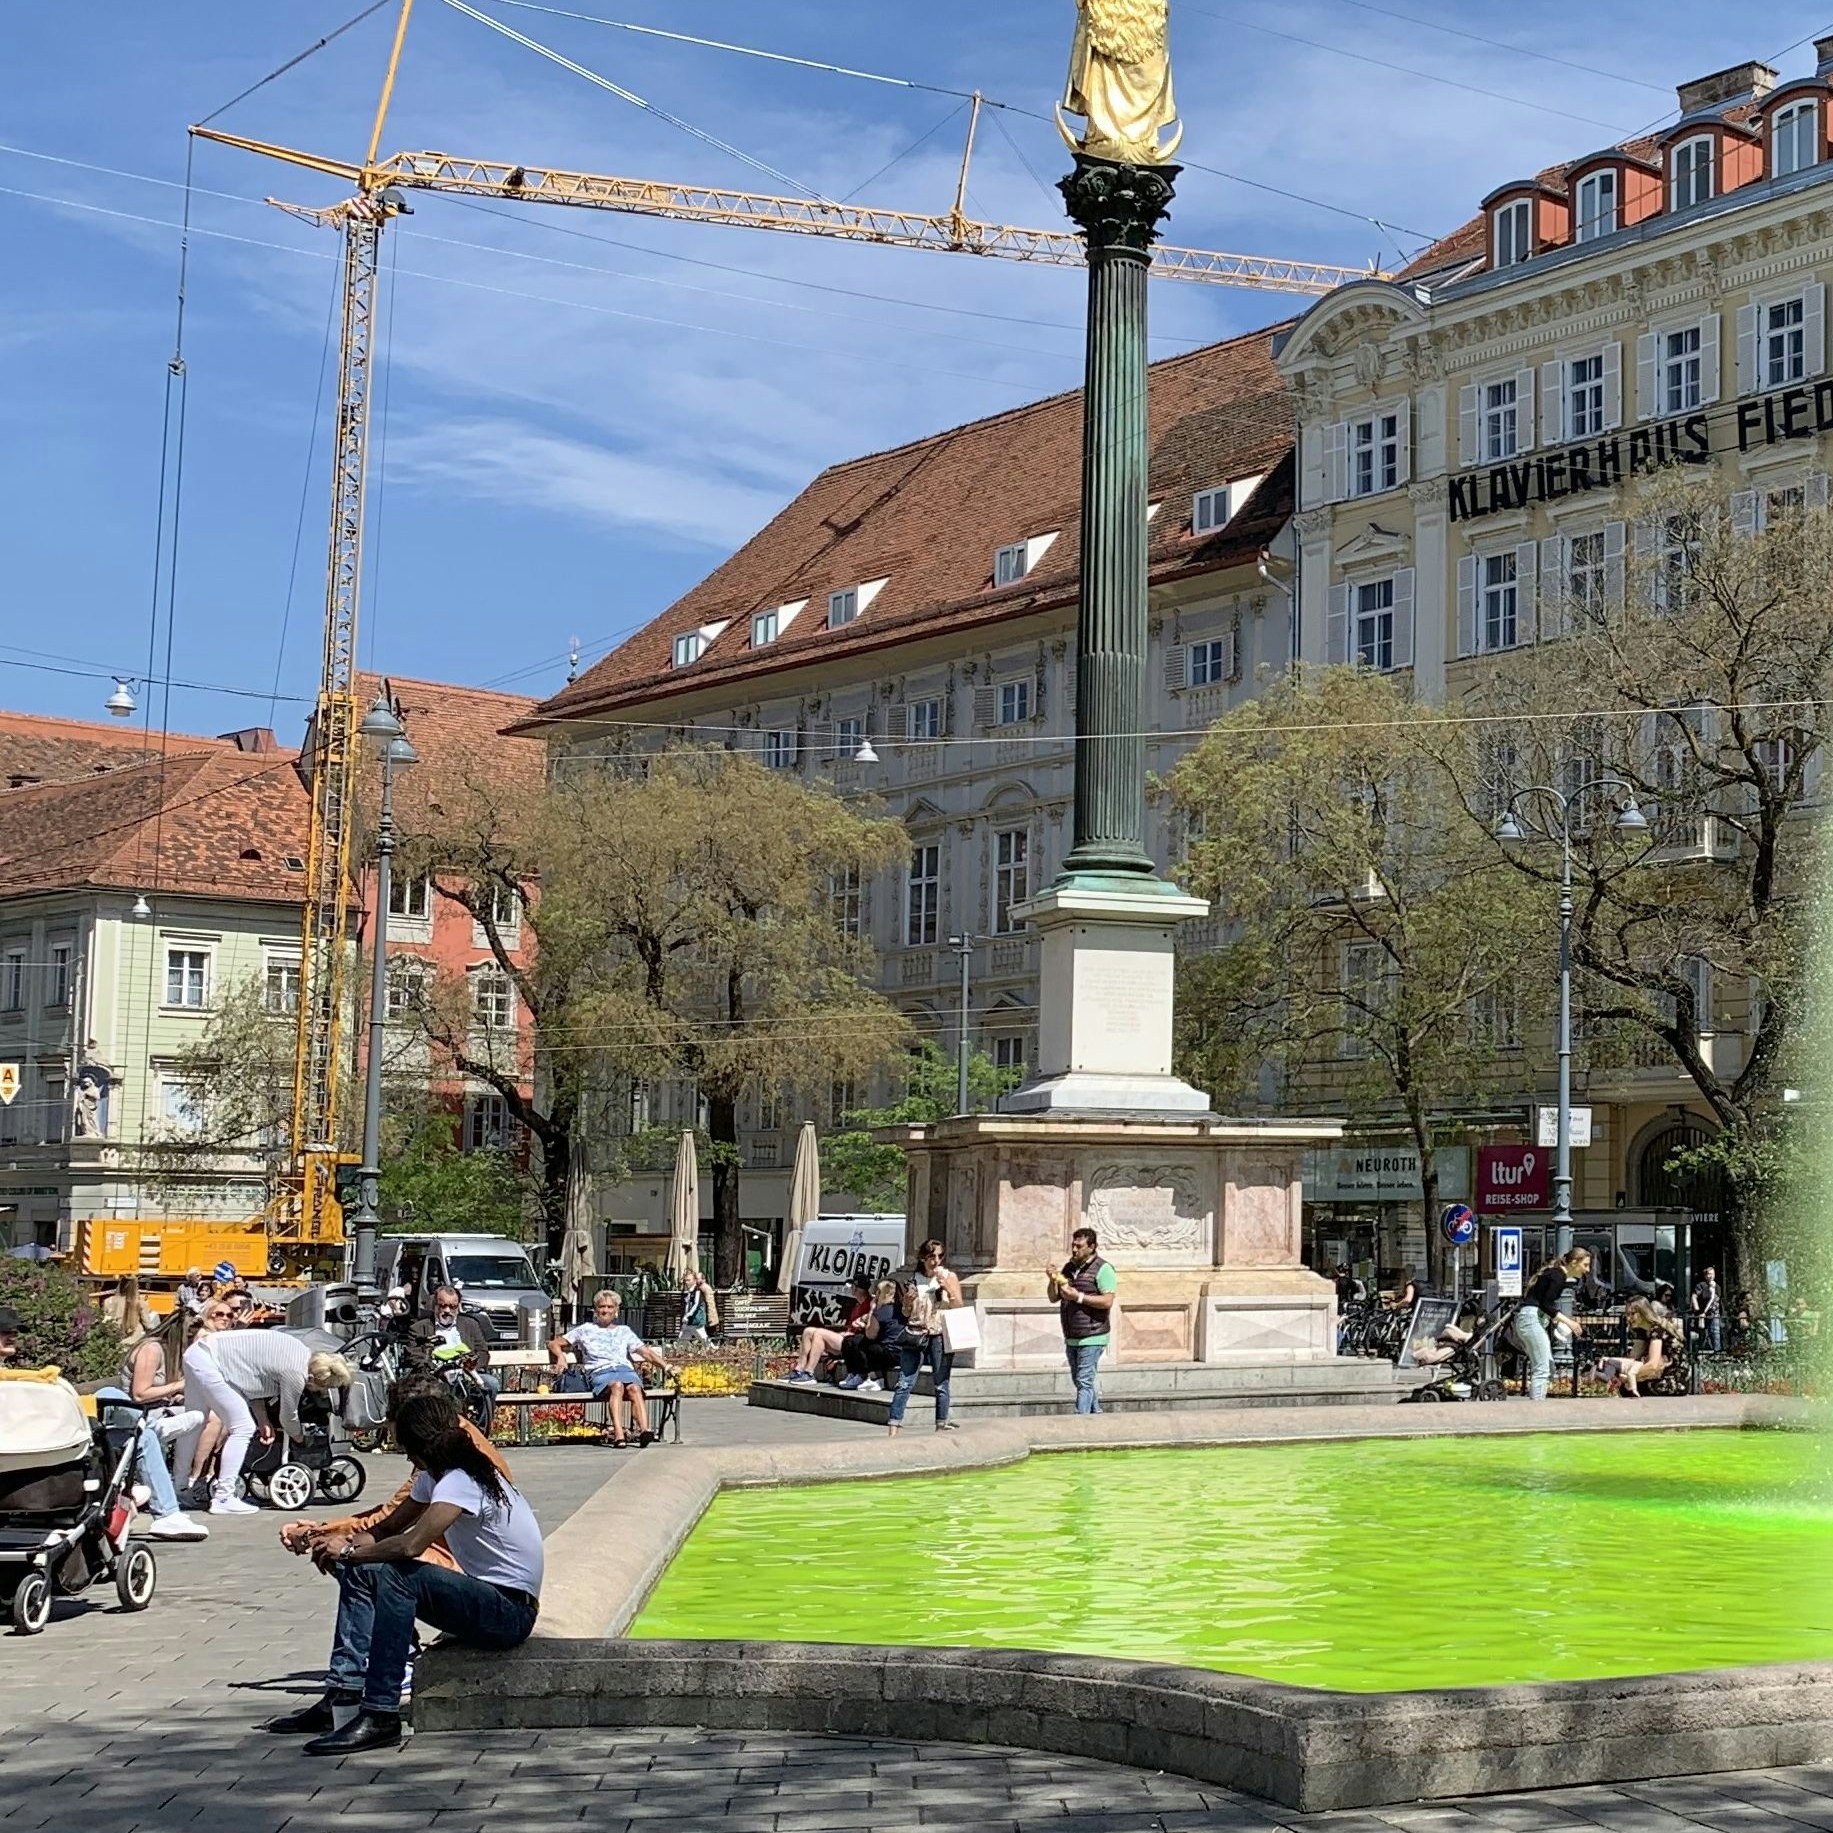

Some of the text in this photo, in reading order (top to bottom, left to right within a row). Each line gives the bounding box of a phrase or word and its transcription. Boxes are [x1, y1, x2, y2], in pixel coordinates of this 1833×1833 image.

[1448, 416, 1709, 522] KLAVIERHAUS
[1356, 1157, 1416, 1173] NEUROTH
[1485, 1194, 1540, 1205] REISE-SHOP
[808, 1243, 891, 1280] KLOIBER
